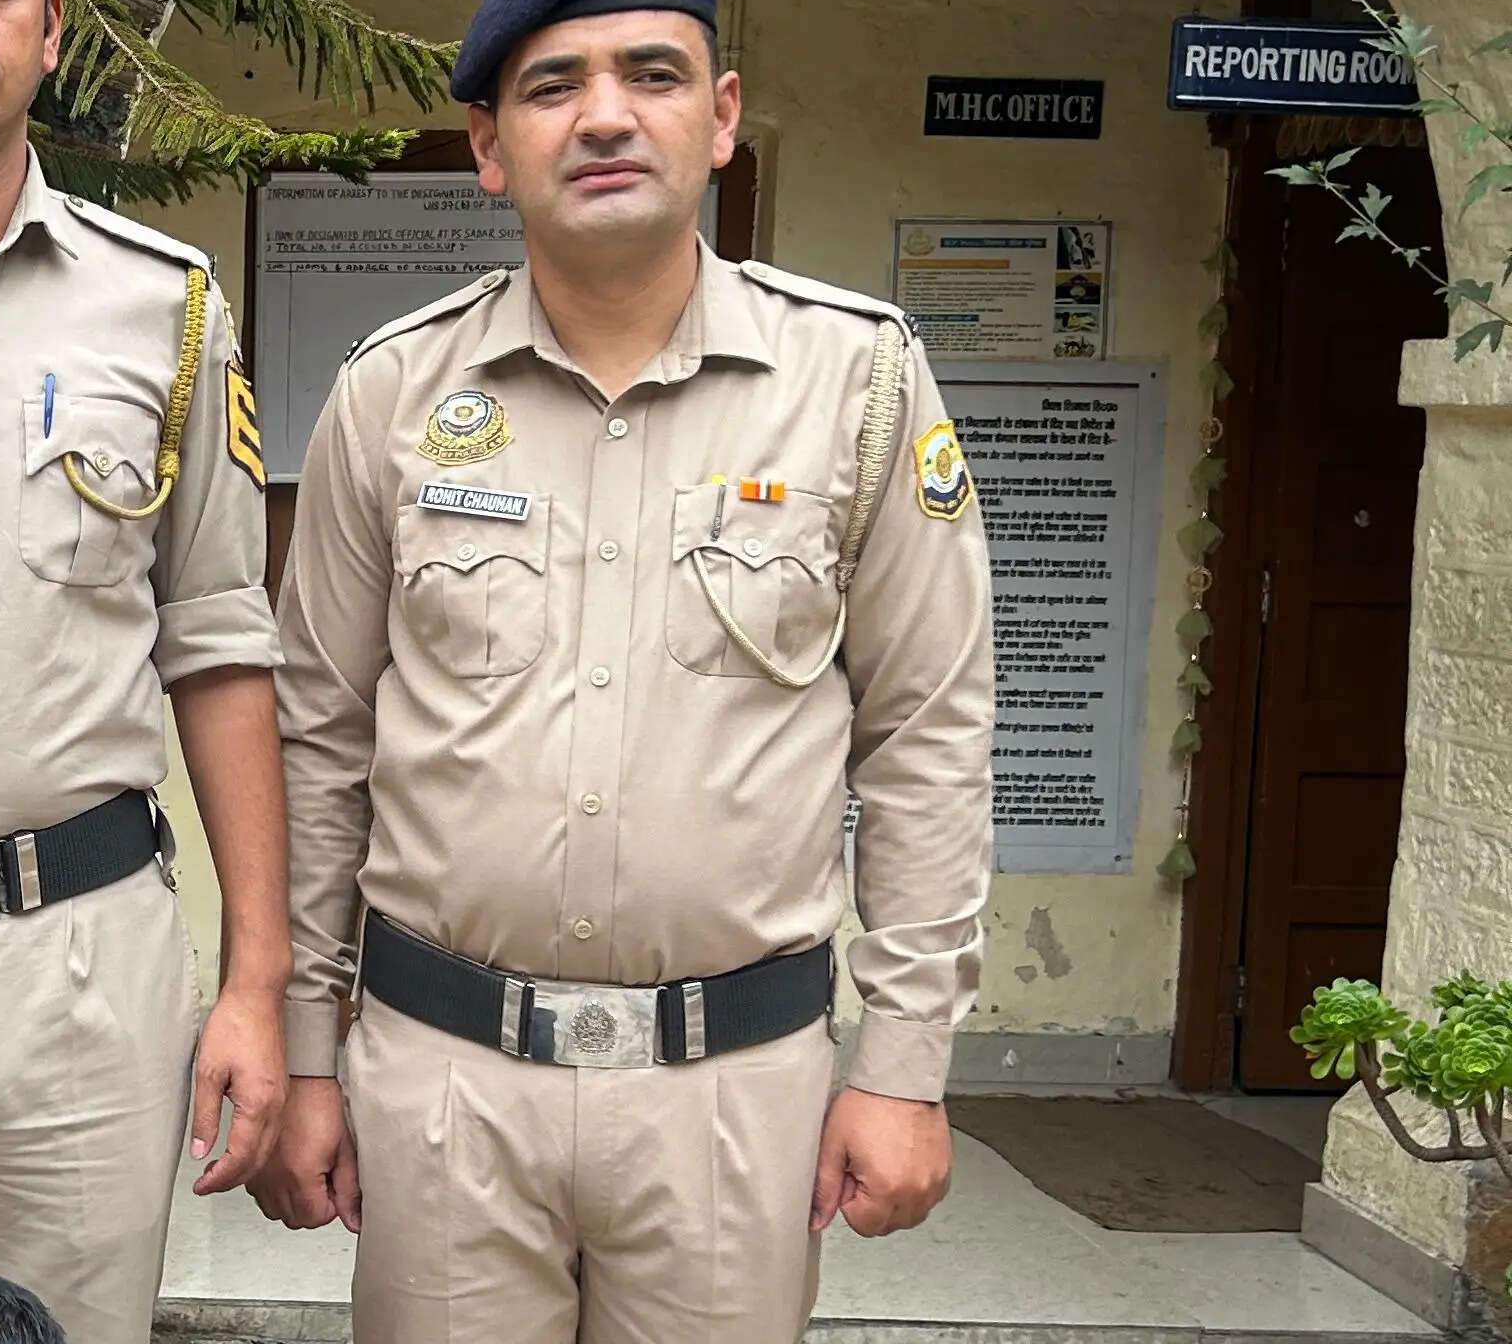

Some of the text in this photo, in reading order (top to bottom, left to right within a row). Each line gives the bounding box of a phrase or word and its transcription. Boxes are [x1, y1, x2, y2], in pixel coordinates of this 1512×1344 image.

[1184, 44, 1347, 84] REPORTING
[1007, 93, 1095, 124] OFFICE
[377, 188, 388, 199] TO
[392, 188, 409, 199] THE
[425, 486, 524, 515] ROHIT CHAUHAN
